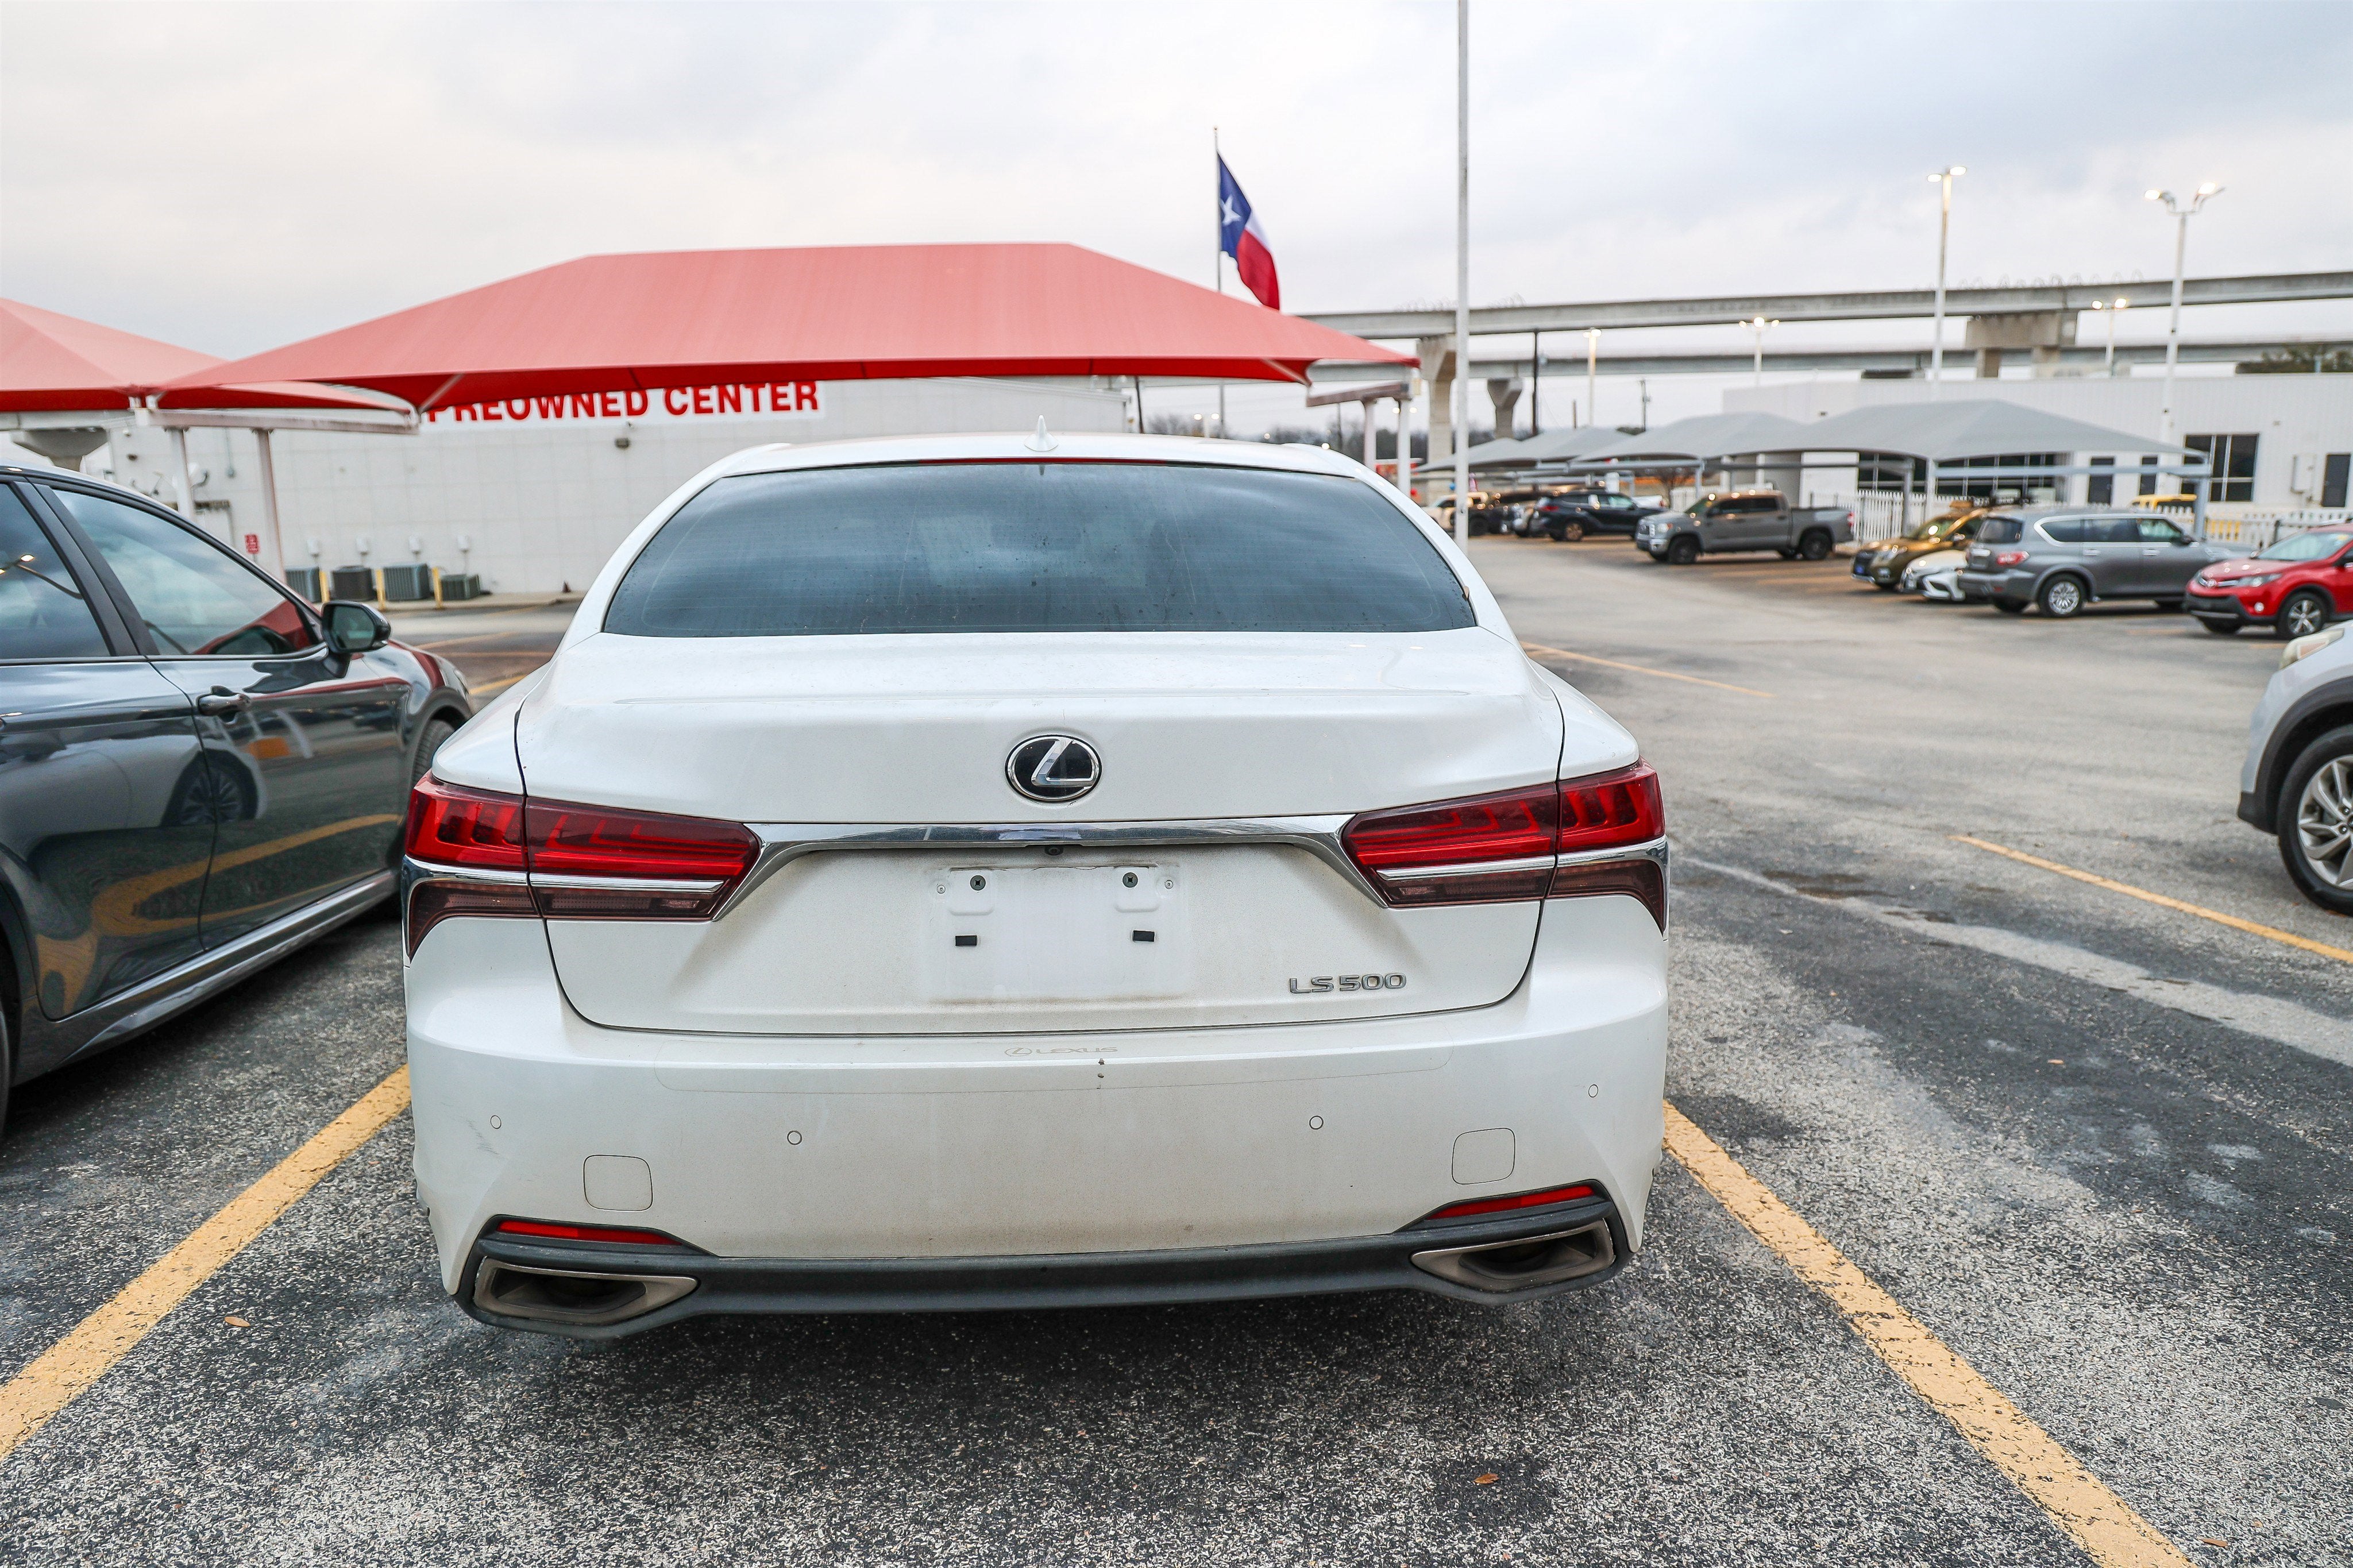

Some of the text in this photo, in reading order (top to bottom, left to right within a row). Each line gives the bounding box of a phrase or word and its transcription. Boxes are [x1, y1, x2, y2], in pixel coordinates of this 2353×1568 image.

[665, 381, 818, 415] CENTER
[1290, 973, 1407, 994] LS 500
